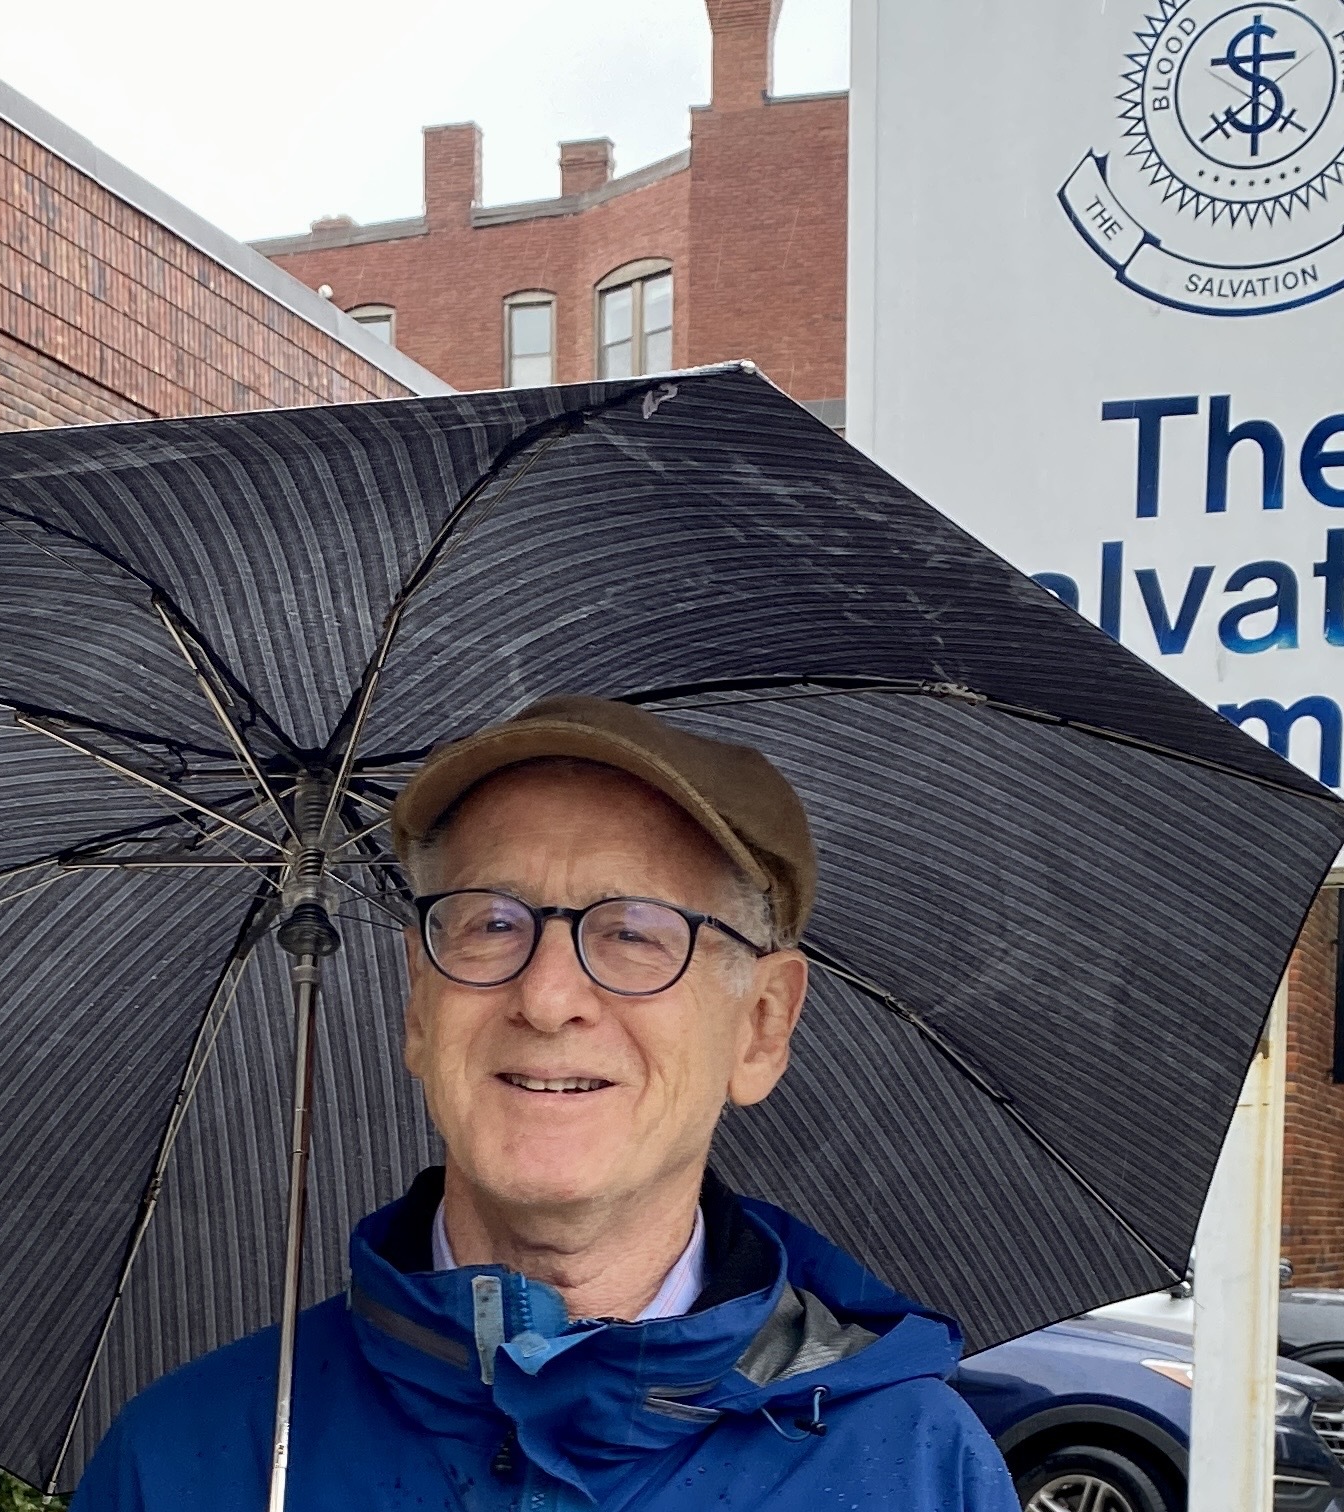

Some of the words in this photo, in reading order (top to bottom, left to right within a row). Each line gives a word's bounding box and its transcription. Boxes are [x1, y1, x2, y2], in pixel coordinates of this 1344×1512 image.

[1152, 16, 1197, 112] BLOOD
[1084, 194, 1125, 242] THE
[1185, 263, 1320, 300] SALVATION
